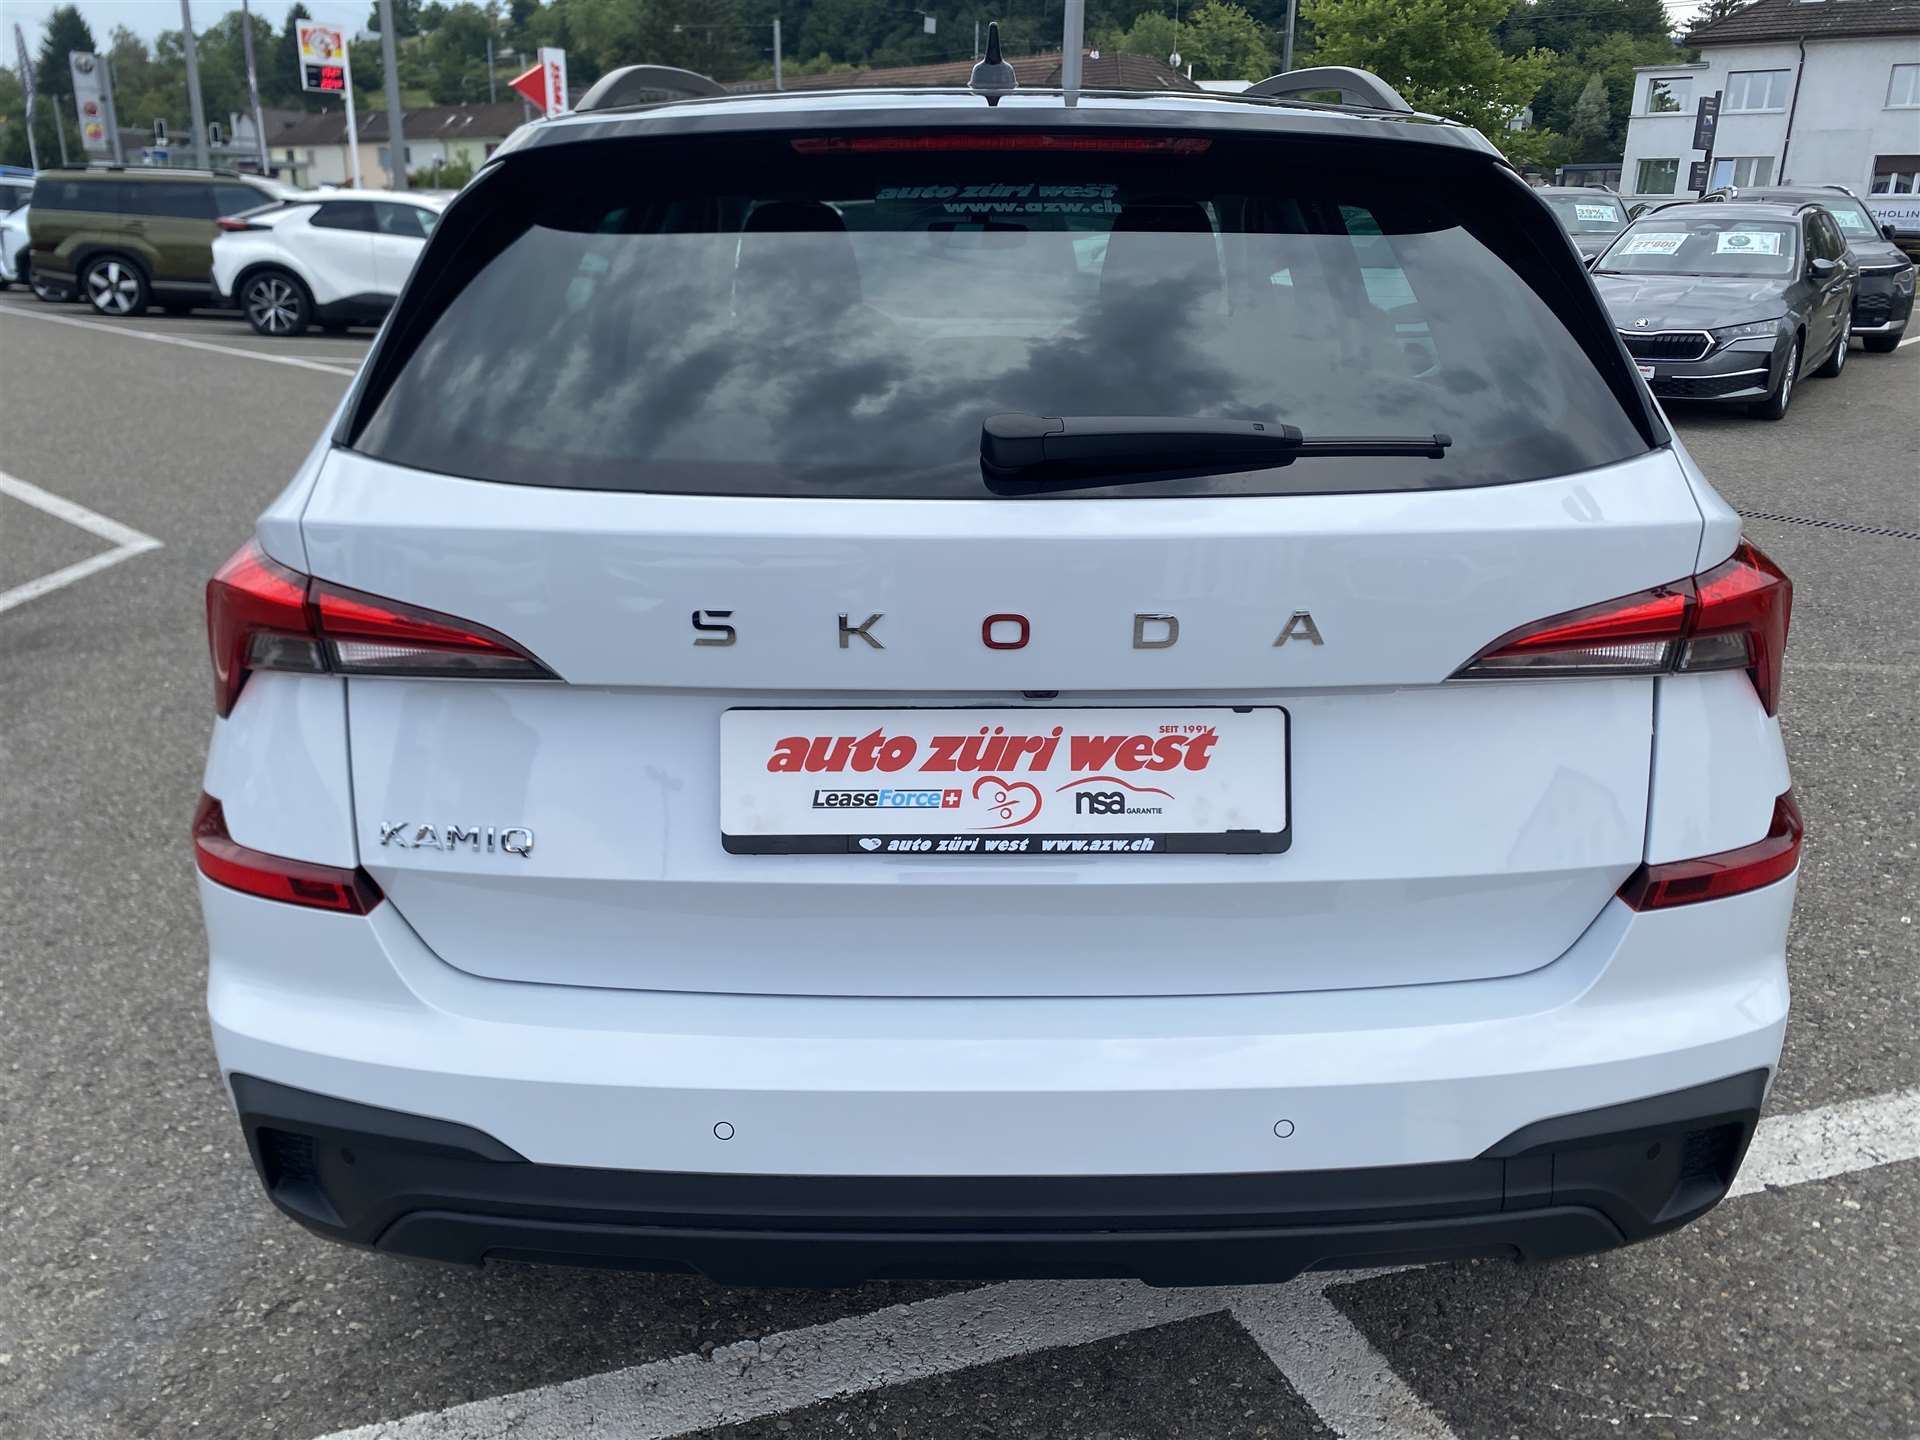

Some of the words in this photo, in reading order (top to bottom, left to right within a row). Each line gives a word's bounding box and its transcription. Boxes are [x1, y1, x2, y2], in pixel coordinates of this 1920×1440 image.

[876, 185, 957, 199] auto
[1039, 183, 1119, 198] west
[944, 200, 1123, 213] www.azw.ch
[1160, 725, 1180, 734] SEIT
[1183, 725, 1208, 734] 1991
[766, 727, 918, 773] auto
[918, 726, 1064, 773] züri
[1070, 726, 1219, 772] west
[812, 789, 941, 807] LeaseForce
[1075, 791, 1125, 815] nsa
[1126, 807, 1163, 815] GARANTIE
[379, 821, 535, 859] KAMIQ
[887, 837, 932, 851] auto
[936, 837, 980, 851] züri
[984, 837, 1030, 851] west
[1041, 837, 1155, 851] www.azw.ch
